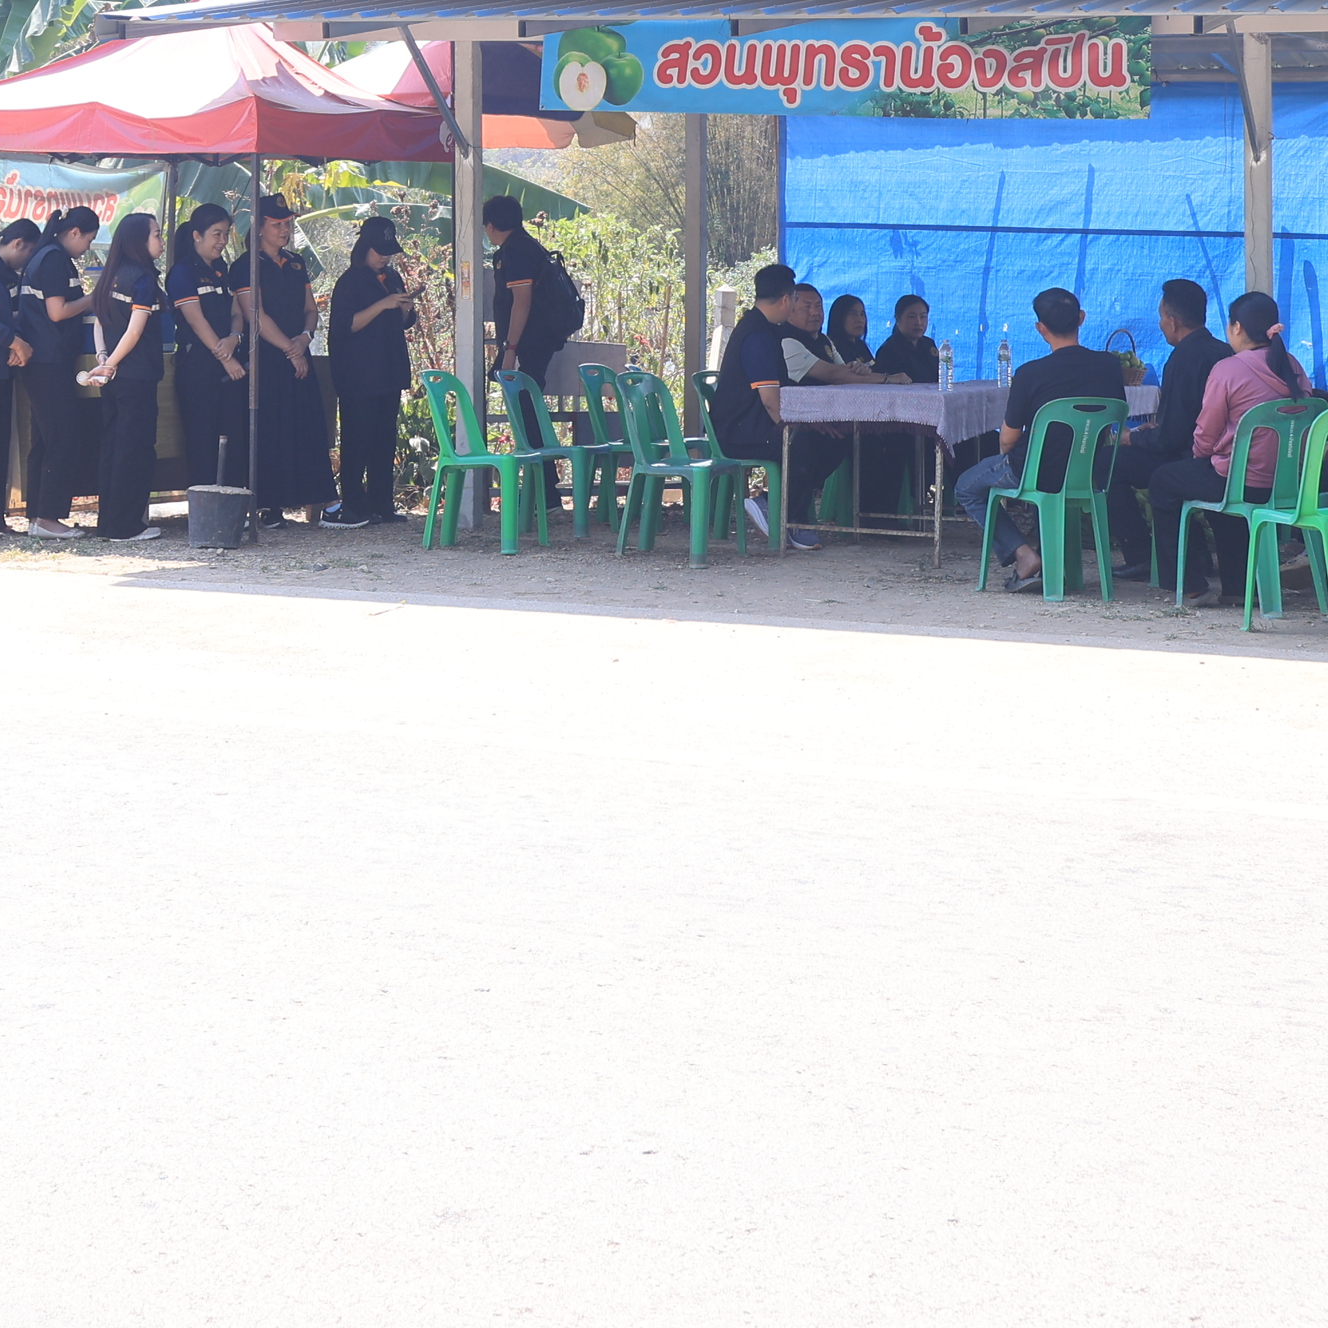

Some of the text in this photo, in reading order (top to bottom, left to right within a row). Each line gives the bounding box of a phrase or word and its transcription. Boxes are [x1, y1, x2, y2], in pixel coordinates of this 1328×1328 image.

[655, 24, 1129, 105] สวนพุทราน้องสปิน
